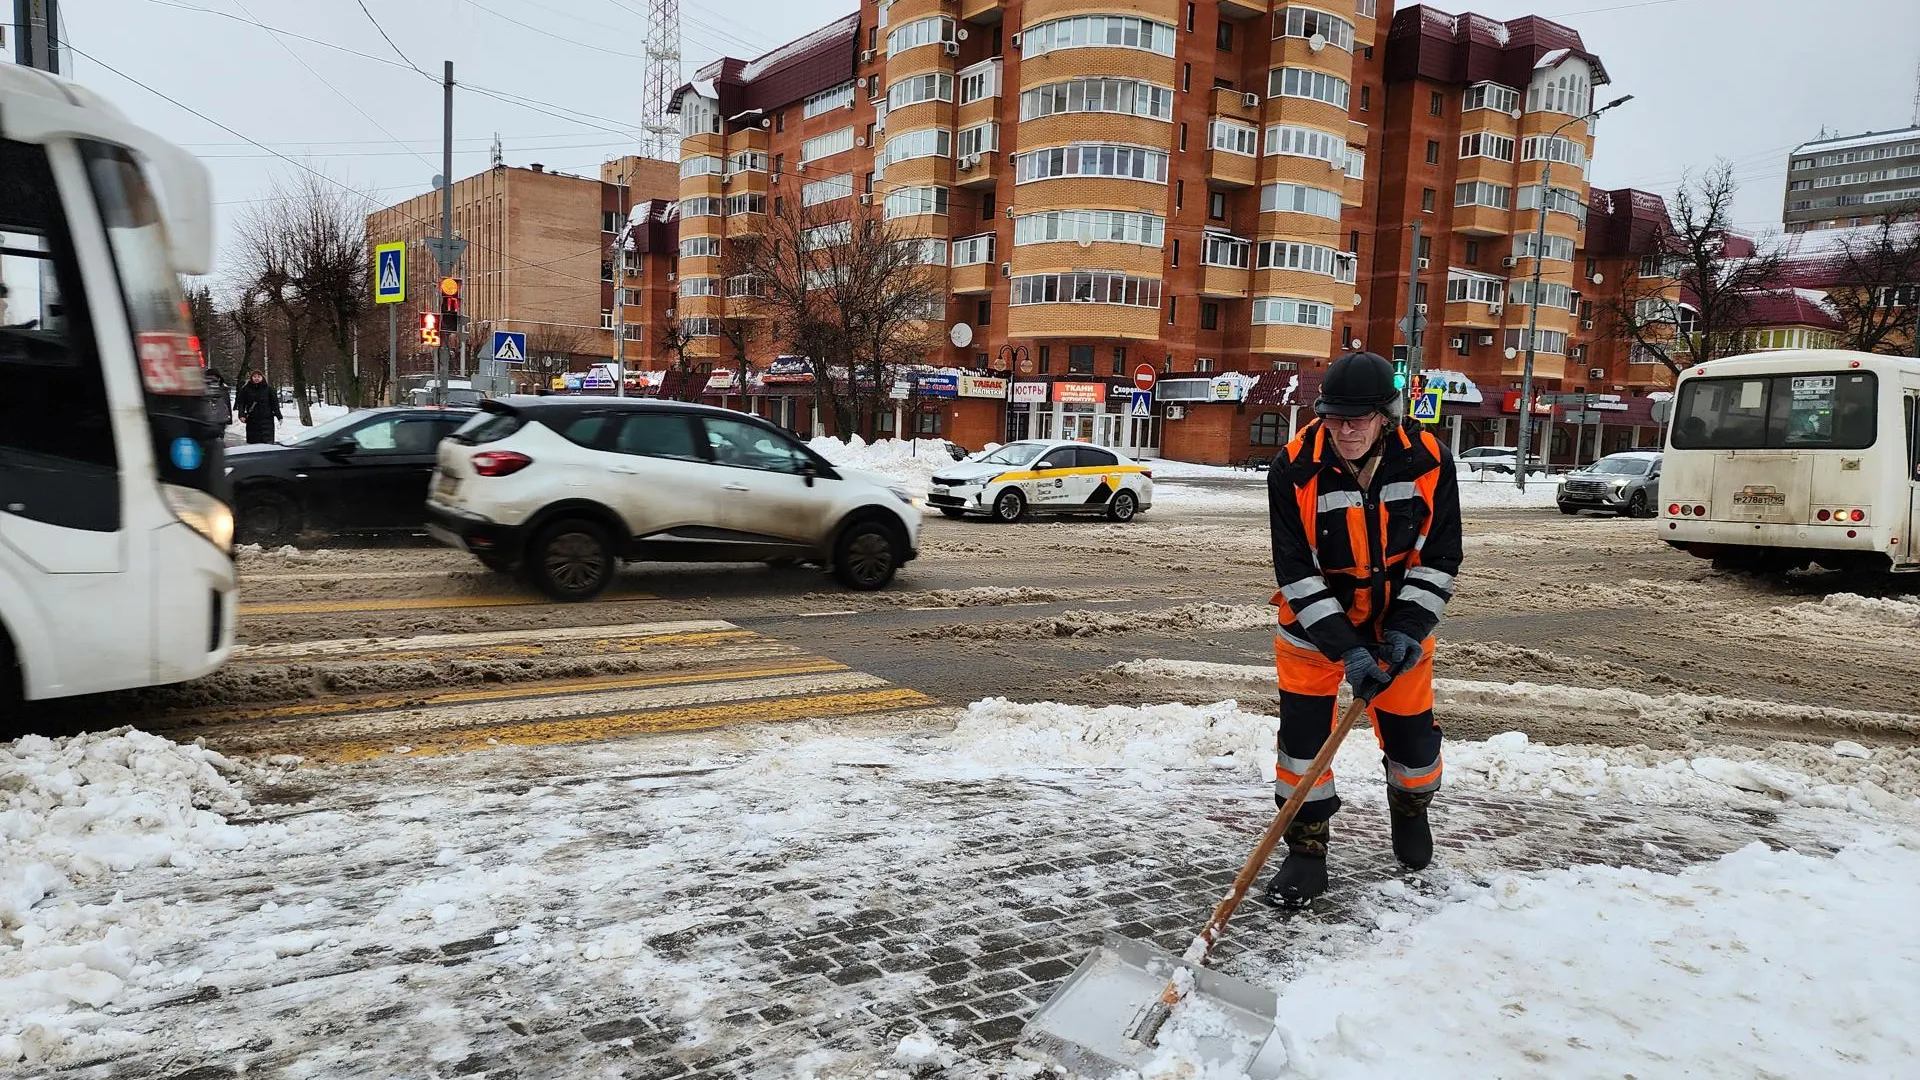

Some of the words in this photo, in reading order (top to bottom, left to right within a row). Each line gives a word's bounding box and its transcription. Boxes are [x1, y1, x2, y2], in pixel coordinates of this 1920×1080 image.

[421, 329, 441, 347] 55
[972, 380, 1003, 389] ТАБАК
[1064, 384, 1094, 392] ТКАНИ
[1010, 385, 1044, 396] ЮСТРЫ
